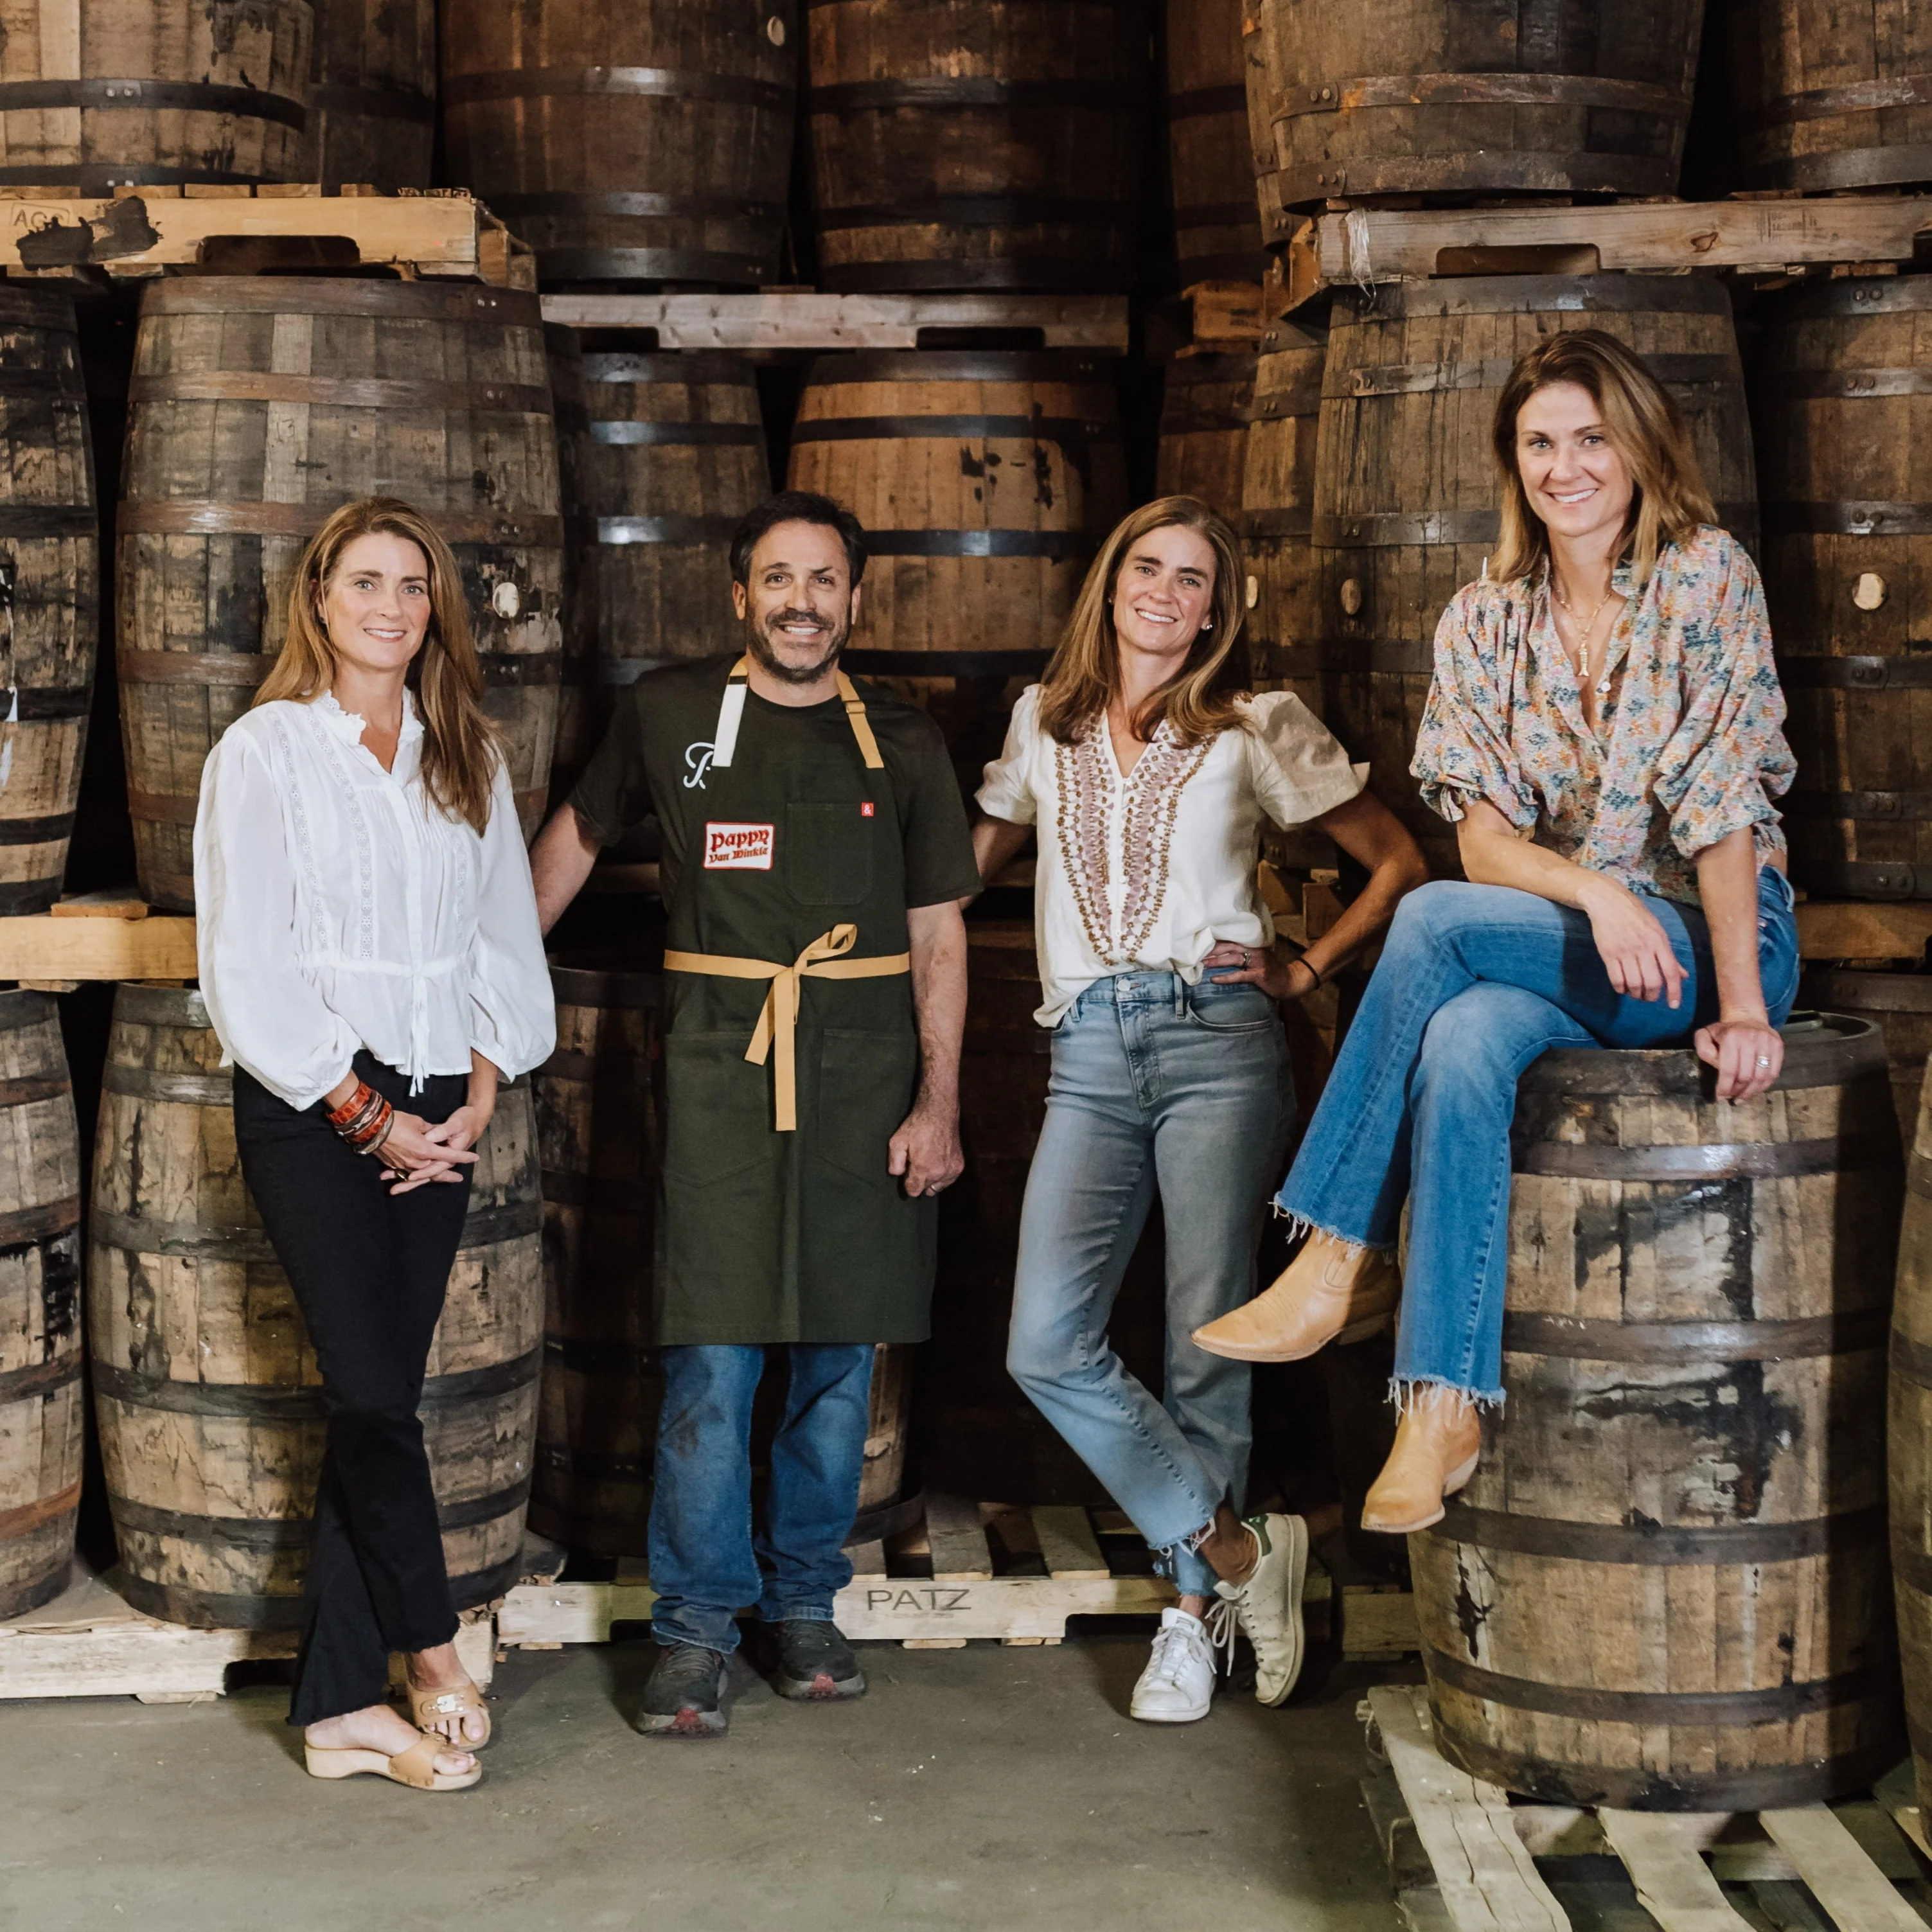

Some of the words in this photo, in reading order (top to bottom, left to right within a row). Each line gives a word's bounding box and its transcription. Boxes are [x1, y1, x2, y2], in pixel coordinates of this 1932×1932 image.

[711, 829, 770, 852] Pappy
[709, 853, 730, 864] Van
[732, 847, 768, 860] Winkle
[867, 1588, 972, 1611] PATZ
